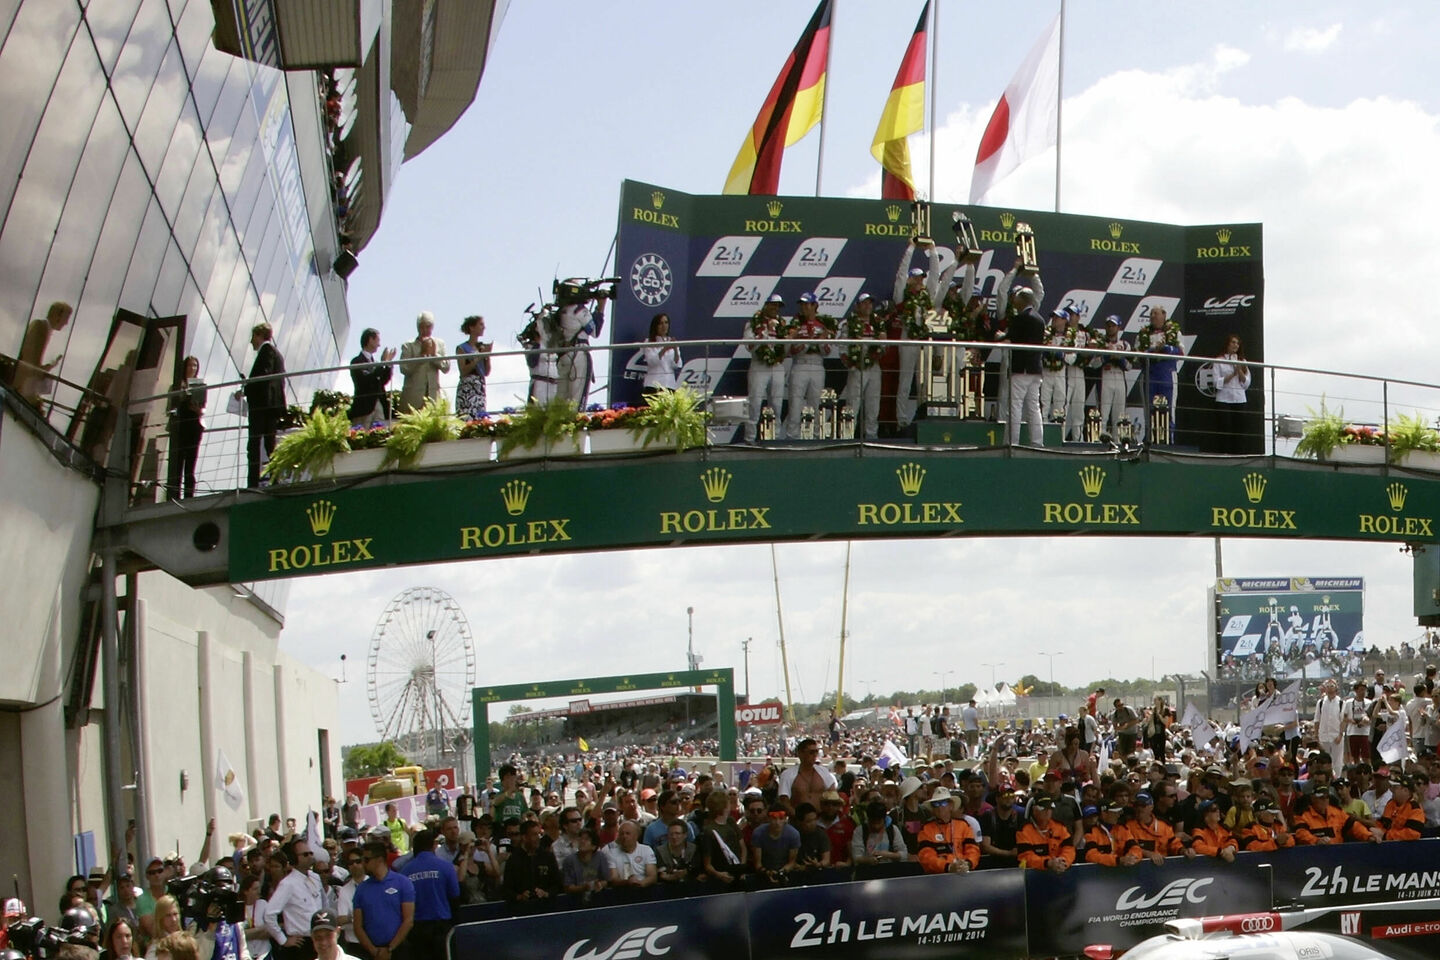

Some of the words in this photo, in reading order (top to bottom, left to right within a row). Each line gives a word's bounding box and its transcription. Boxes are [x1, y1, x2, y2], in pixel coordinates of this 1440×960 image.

[633, 208, 680, 229] ROLEX
[745, 220, 802, 233] ROLEX
[715, 246, 743, 261] 24h
[800, 247, 830, 262] 24h
[1090, 239, 1140, 254] ROLEX
[1196, 246, 1251, 258] ROLEX
[1122, 266, 1146, 281] 24h
[732, 286, 761, 301] 24h
[818, 286, 847, 302] 24h
[1203, 294, 1256, 309] WEC
[986, 431, 996, 446] 1
[660, 507, 772, 534] ROLEX
[857, 502, 964, 526] ROLEX
[1043, 503, 1140, 525] ROLEX
[1211, 508, 1297, 530] ROLEX
[1359, 514, 1434, 537] ROLEX
[460, 518, 572, 550] ROLEX
[268, 538, 374, 572] ROLEX
[1242, 580, 1288, 588] MICHELIN
[1300, 865, 1348, 897] 24h
[1352, 874, 1382, 893] LE
[1116, 877, 1214, 911] WEC
[1088, 916, 1101, 924] FIA
[1102, 914, 1130, 922] WORLD
[1130, 908, 1180, 920] ENDURANCE
[1340, 913, 1362, 935] HY
[790, 909, 850, 948] 24h
[857, 918, 896, 941] LE
[900, 908, 989, 936] MANS
[1385, 924, 1412, 936] Audi
[918, 935, 941, 945] 14-15
[944, 933, 963, 943] JUIN
[964, 930, 986, 941] 2014
[1299, 946, 1320, 957] ORIS
